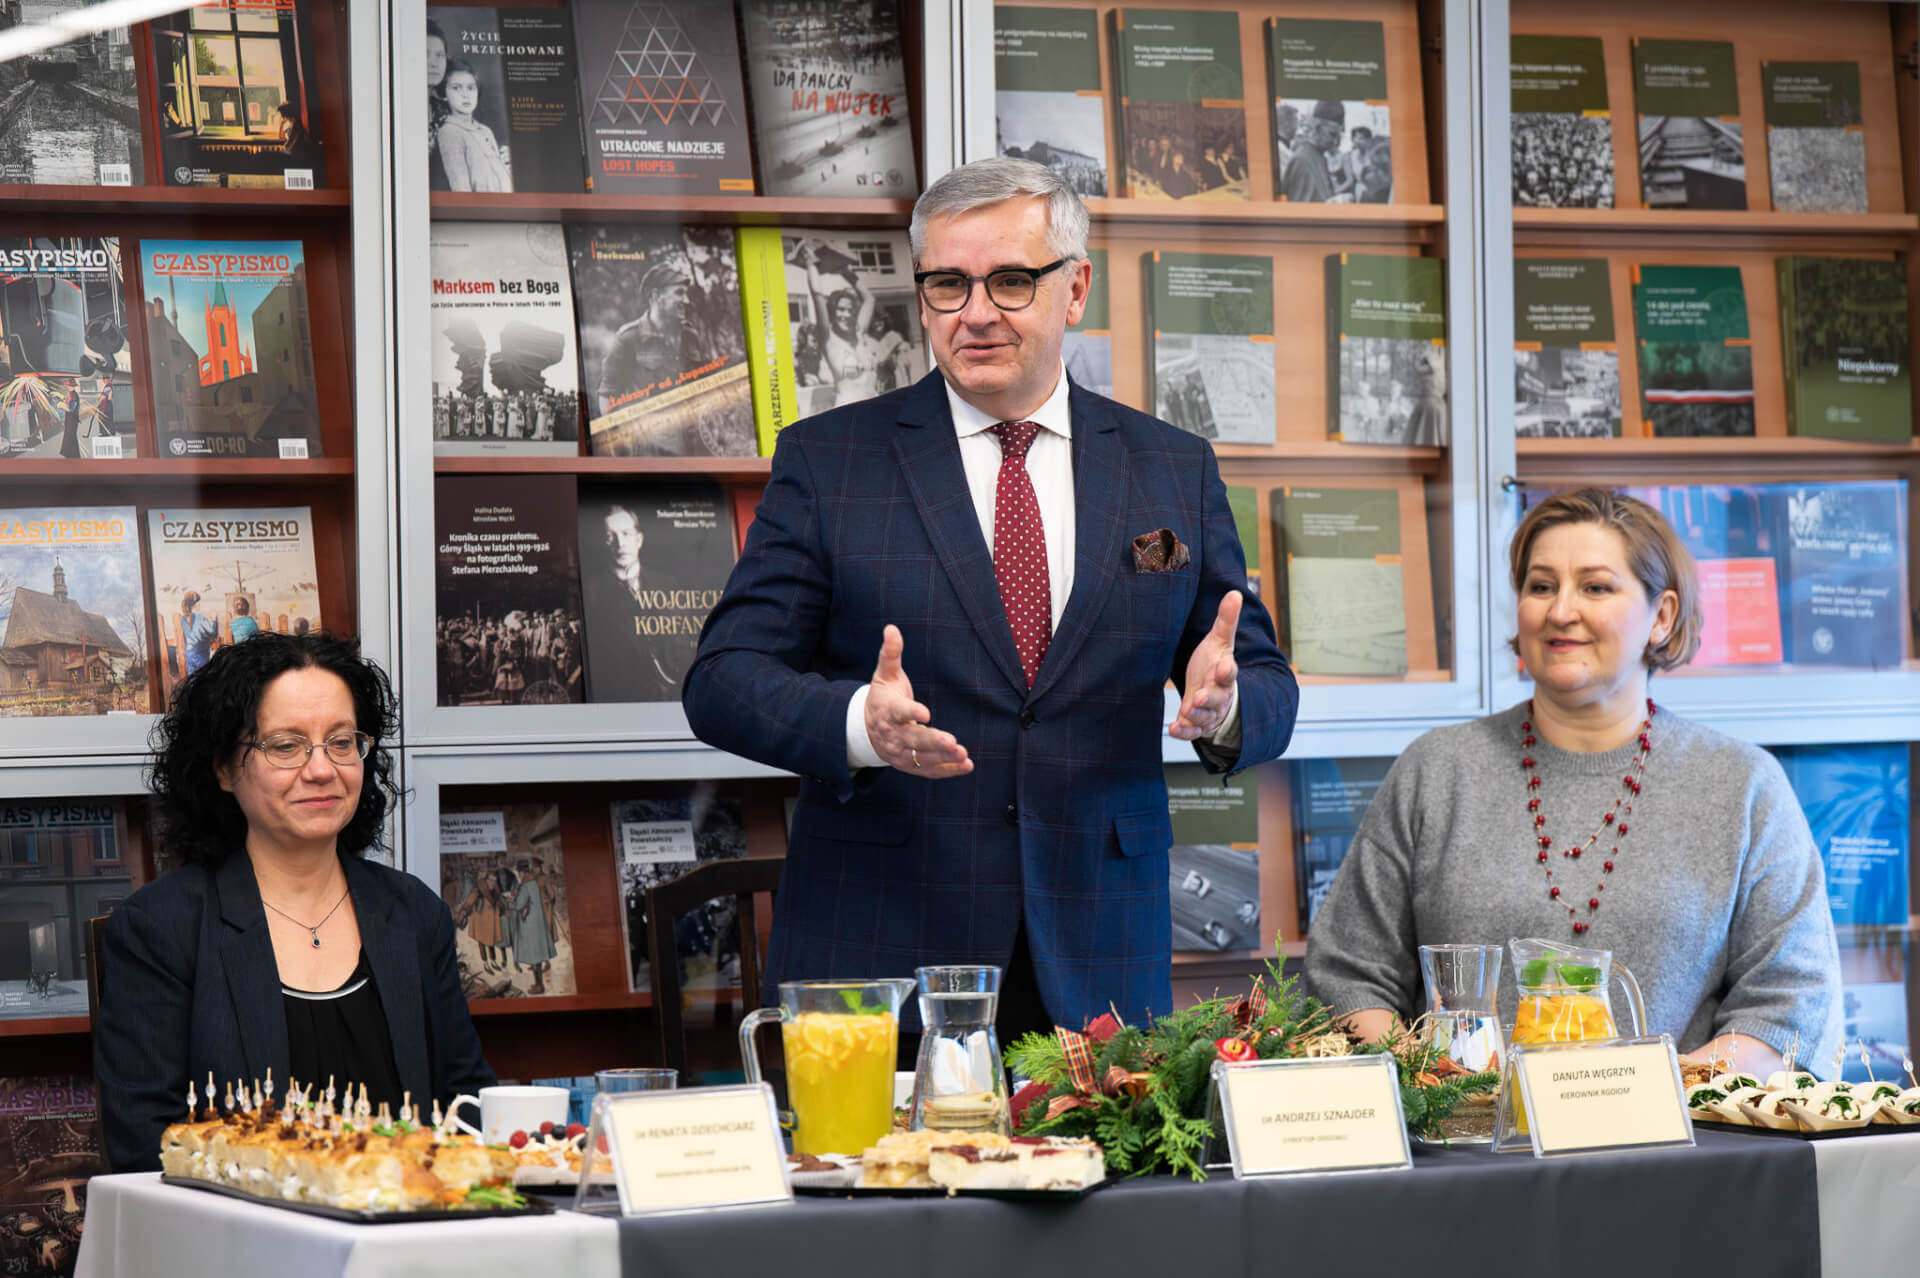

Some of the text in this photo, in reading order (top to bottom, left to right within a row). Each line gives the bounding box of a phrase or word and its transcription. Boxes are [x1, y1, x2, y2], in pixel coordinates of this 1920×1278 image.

[463, 44, 565, 56] PRZECHOWANE
[801, 71, 853, 91] PANCRY
[792, 90, 897, 117] NA WUJEK
[600, 139, 726, 155] UTRACONE NADZIEJE
[602, 159, 675, 172] LOST HOPES
[152, 253, 290, 277] CZASYPISMO
[433, 279, 559, 295] Marksem bez Boga
[1838, 358, 1899, 376] Niepokorny
[162, 519, 299, 543] CZASYPISMO
[449, 533, 479, 542] Kronika
[480, 534, 500, 542] czasu
[440, 543, 461, 555] Górny
[463, 542, 482, 554] Śląsk
[492, 543, 515, 552] latach
[467, 553, 523, 565] na fotografiach
[452, 564, 538, 575] Stefana Pierzchalskiego
[634, 615, 708, 636] KORFAN
[0, 804, 114, 828] ASYPISMO
[1552, 1066, 1635, 1082] DANUTA WĘGRZYN
[0, 1086, 97, 1112] ASYPIS
[1560, 1090, 1599, 1100] KIEROWNIK
[1275, 1110, 1320, 1124] ANDRZEJ
[1323, 1108, 1375, 1121] SZNAJDER
[648, 1125, 688, 1138] RENATA
